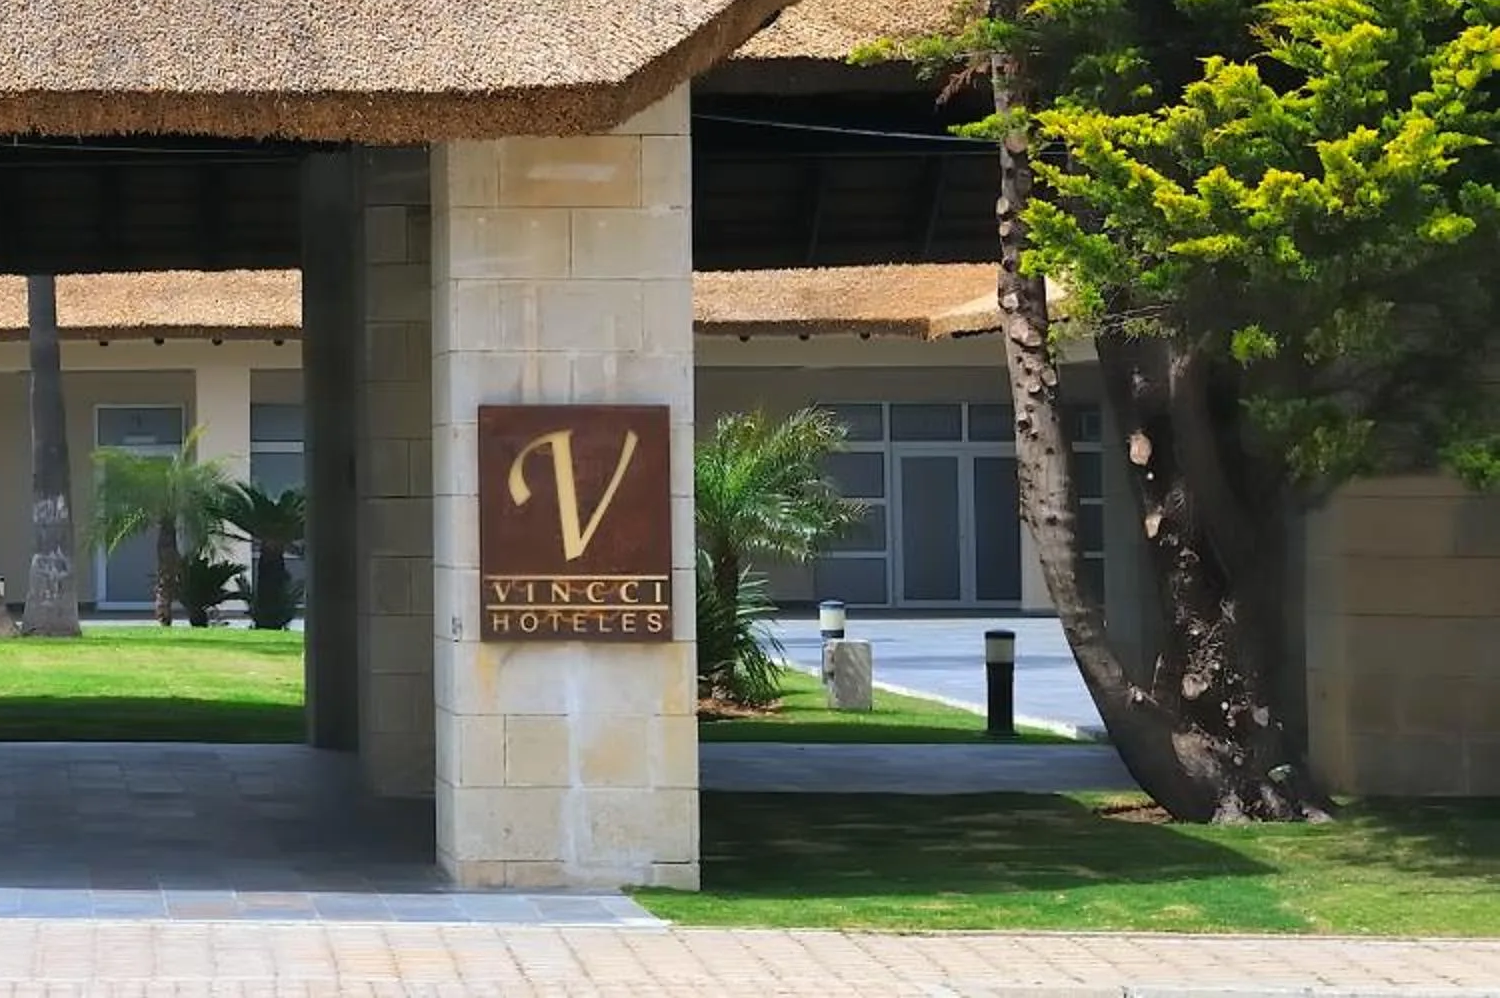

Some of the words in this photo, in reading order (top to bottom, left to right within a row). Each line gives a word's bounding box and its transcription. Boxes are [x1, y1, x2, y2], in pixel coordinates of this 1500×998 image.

[507, 428, 638, 562] V
[493, 581, 662, 603] VINCCI
[493, 613, 663, 633] HOTELES
